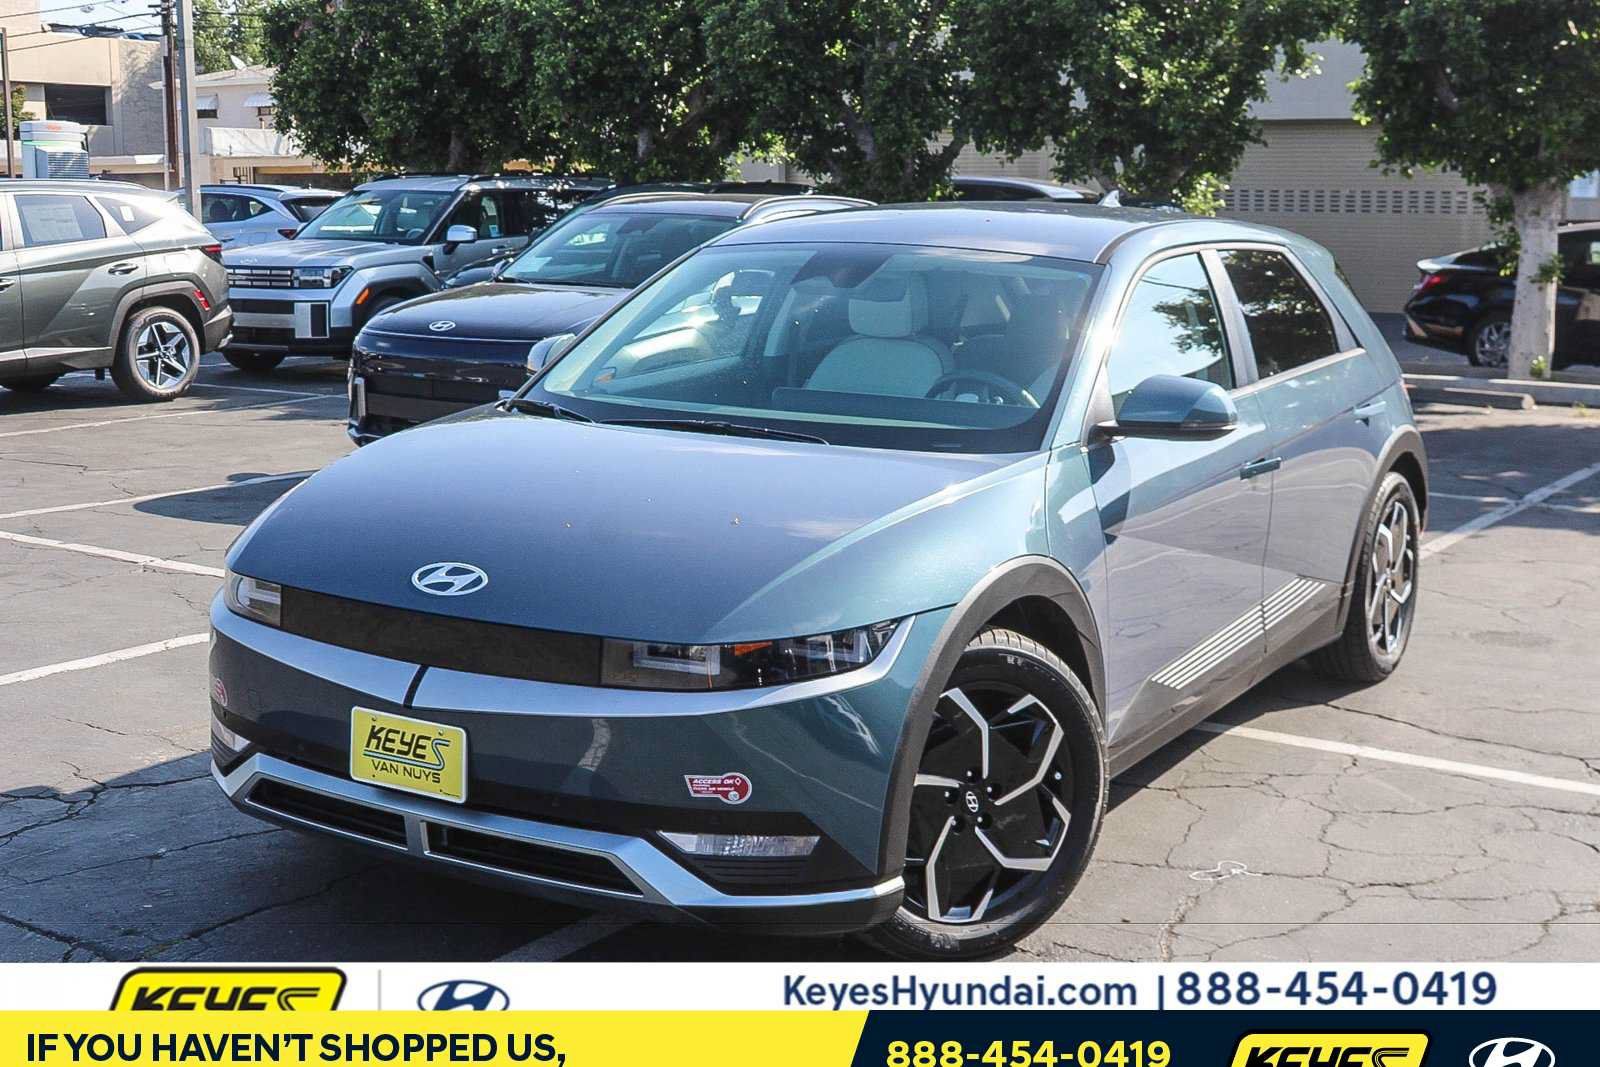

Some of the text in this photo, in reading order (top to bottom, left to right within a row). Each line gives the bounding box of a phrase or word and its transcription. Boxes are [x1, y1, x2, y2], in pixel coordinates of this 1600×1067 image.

[364, 724, 451, 771] KEYES
[371, 759, 441, 784] VAN NUYS
